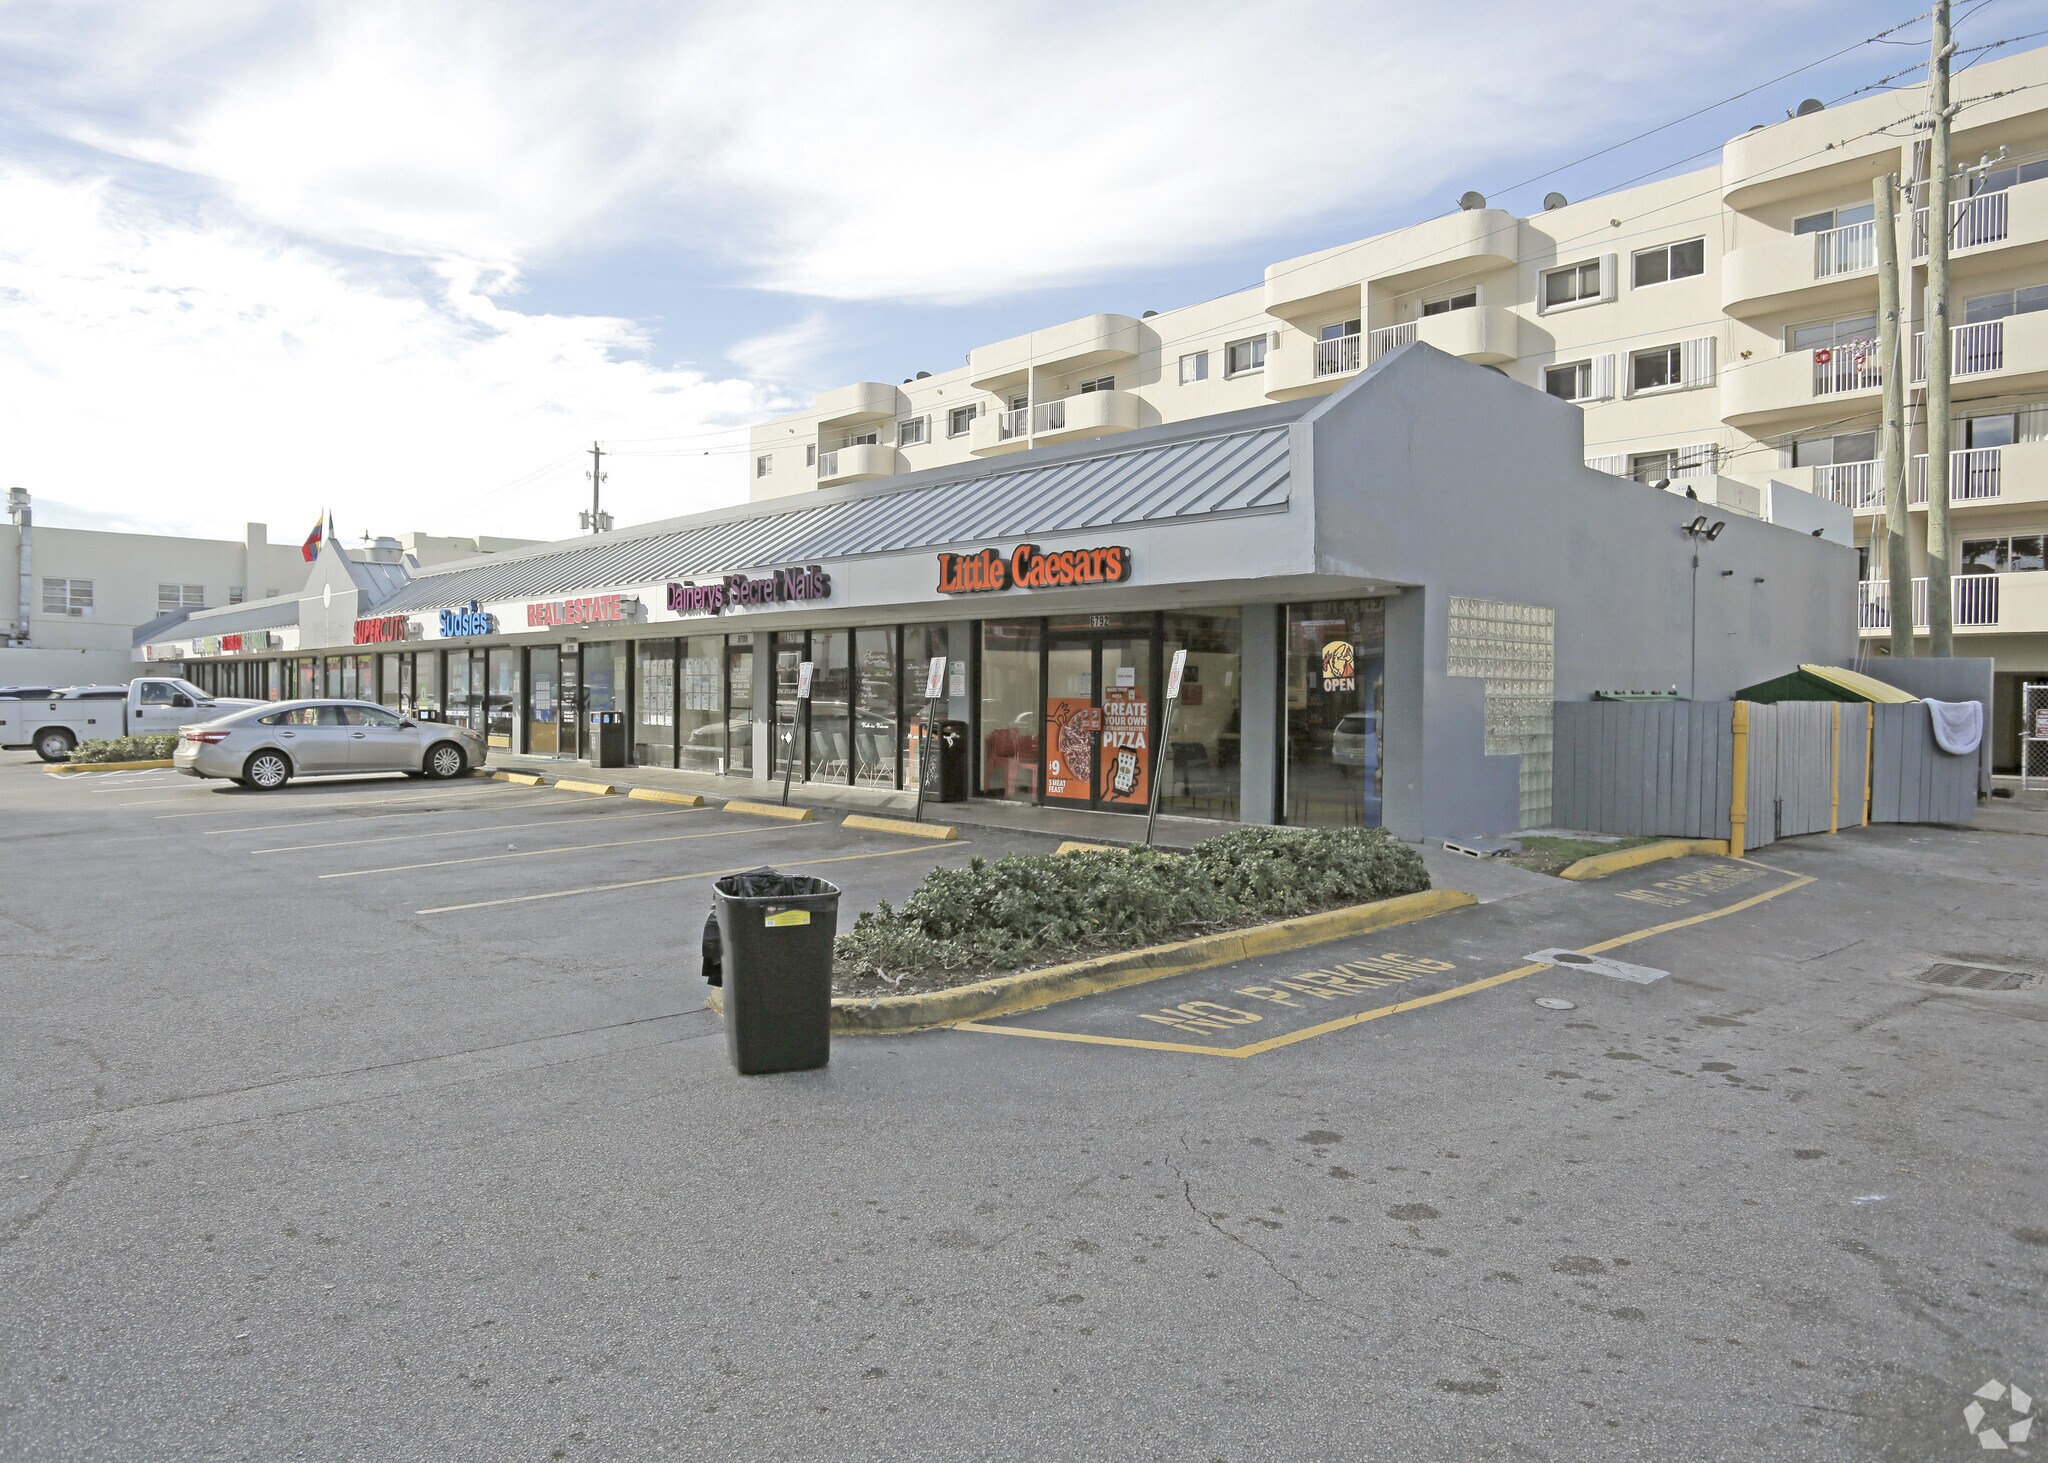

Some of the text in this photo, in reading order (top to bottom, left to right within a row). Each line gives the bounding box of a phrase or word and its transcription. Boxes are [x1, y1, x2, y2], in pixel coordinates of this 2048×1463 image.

[938, 544, 1122, 593] Little Caesars
[731, 573, 781, 605] Secret
[784, 567, 826, 602] Nails
[440, 600, 490, 637] Sudsies
[527, 594, 621, 627] REAL ESTATE
[1090, 616, 1109, 627] 6792
[354, 615, 405, 644] SUPERCUTS
[1323, 678, 1355, 692] OPEN
[1103, 702, 1147, 716] CREATE
[1104, 716, 1147, 726] YOUR OWN
[1103, 731, 1146, 749] PIZZA
[1137, 952, 1456, 1035] NO PARKING
